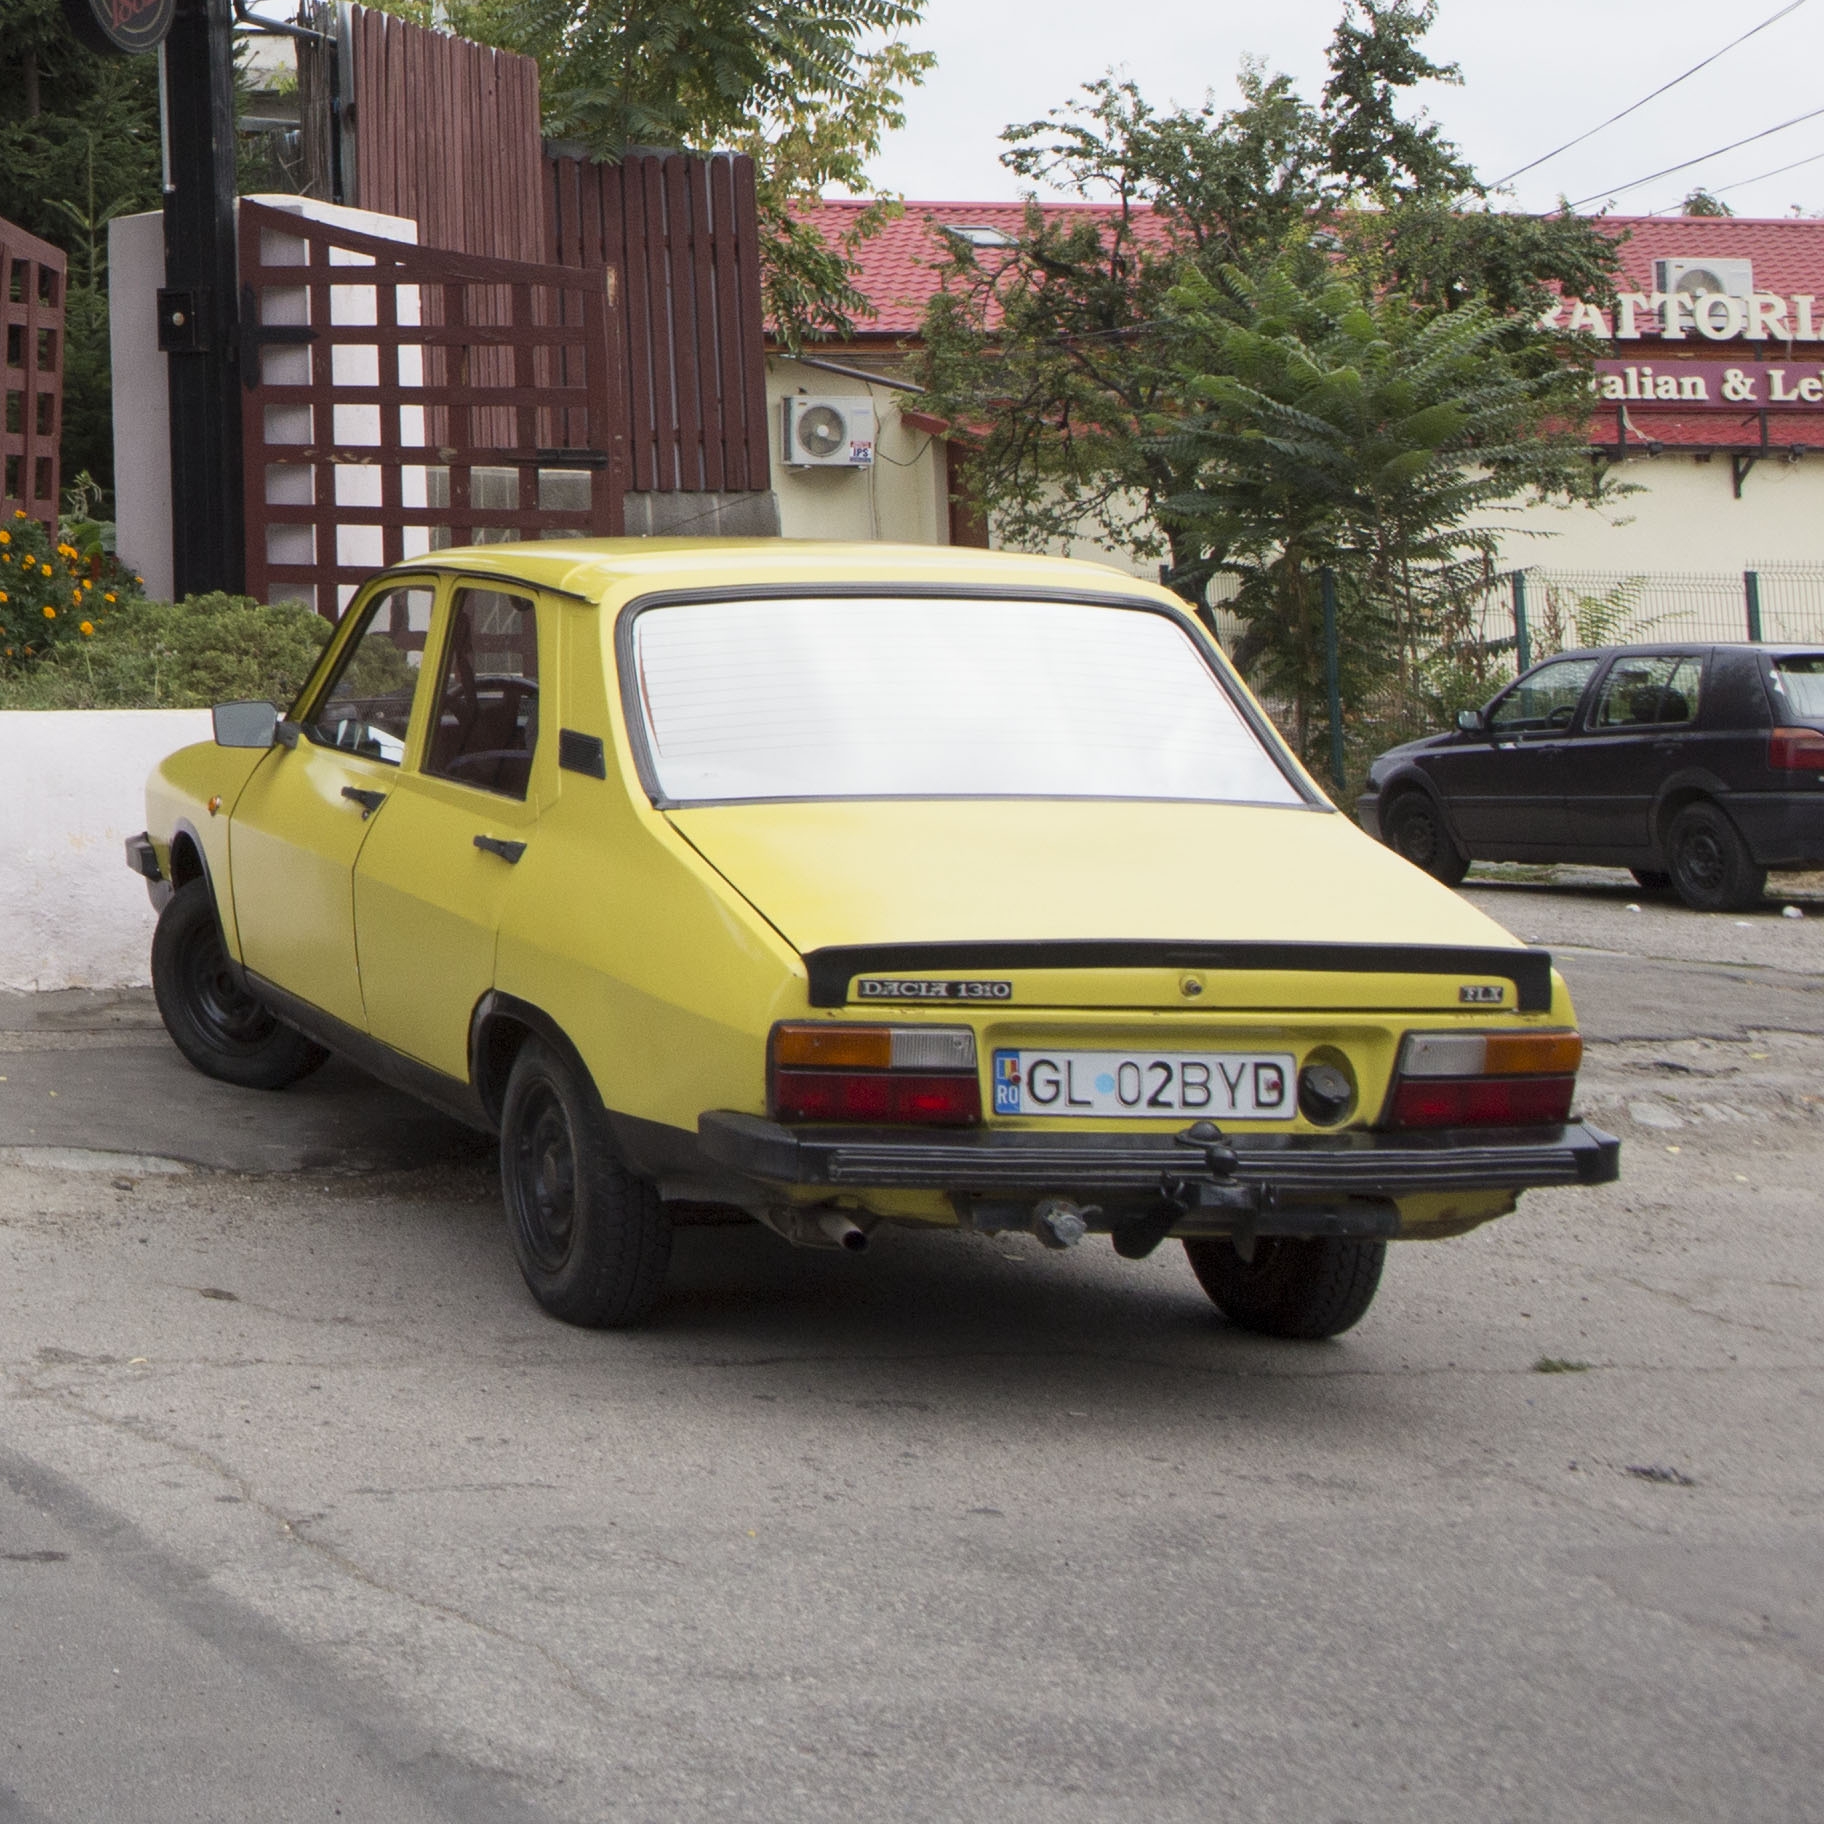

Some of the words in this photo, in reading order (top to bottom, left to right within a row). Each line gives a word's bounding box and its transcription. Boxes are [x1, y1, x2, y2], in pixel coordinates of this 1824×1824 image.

[1722, 368, 1758, 402] &
[1767, 368, 1824, 402] Le
[862, 980, 949, 997] DACIA
[957, 982, 1011, 998] 1310
[998, 1084, 1020, 1105] RO
[1026, 1059, 1092, 1108] GL
[1114, 1060, 1287, 1109] 02BYD
